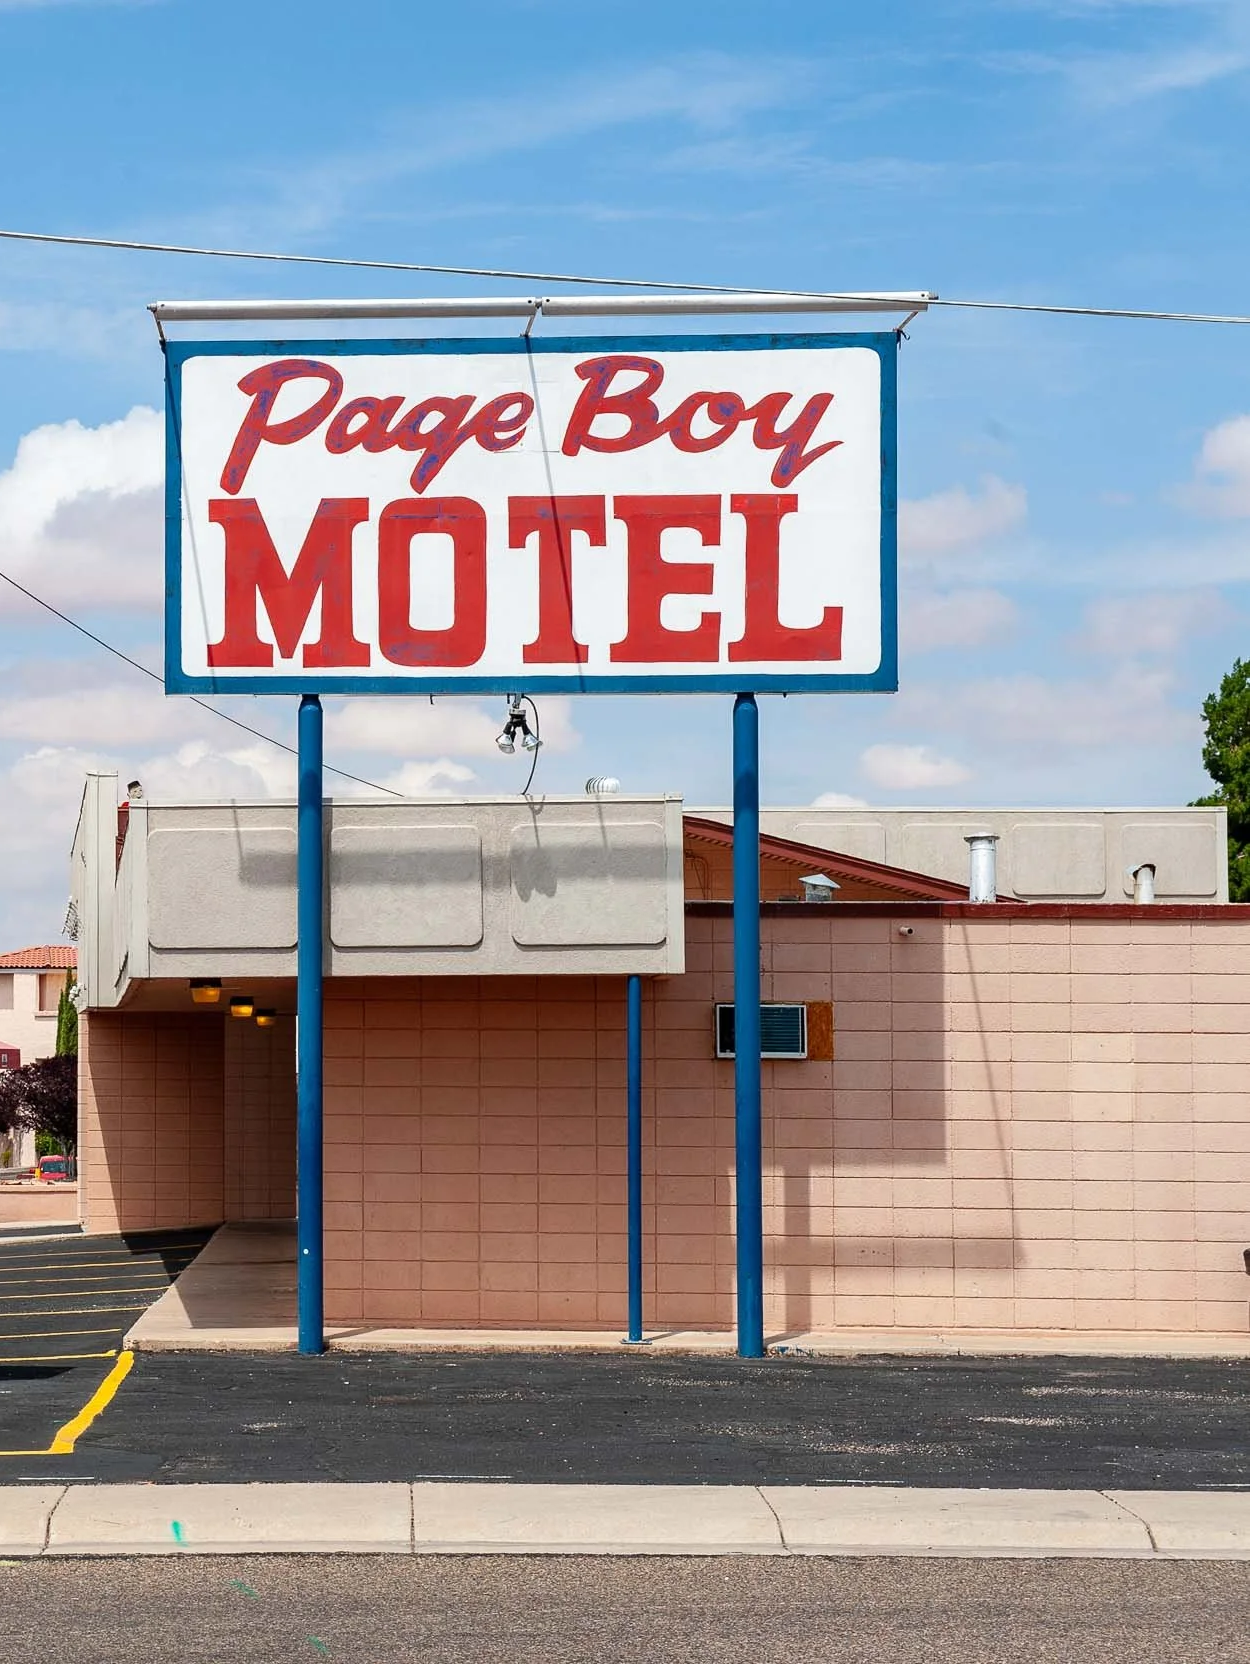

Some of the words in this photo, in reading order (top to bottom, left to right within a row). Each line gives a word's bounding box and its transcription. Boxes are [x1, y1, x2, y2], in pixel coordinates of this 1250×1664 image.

[220, 358, 534, 496] Page
[561, 355, 845, 489] Boy
[207, 493, 844, 669] MOTEL
